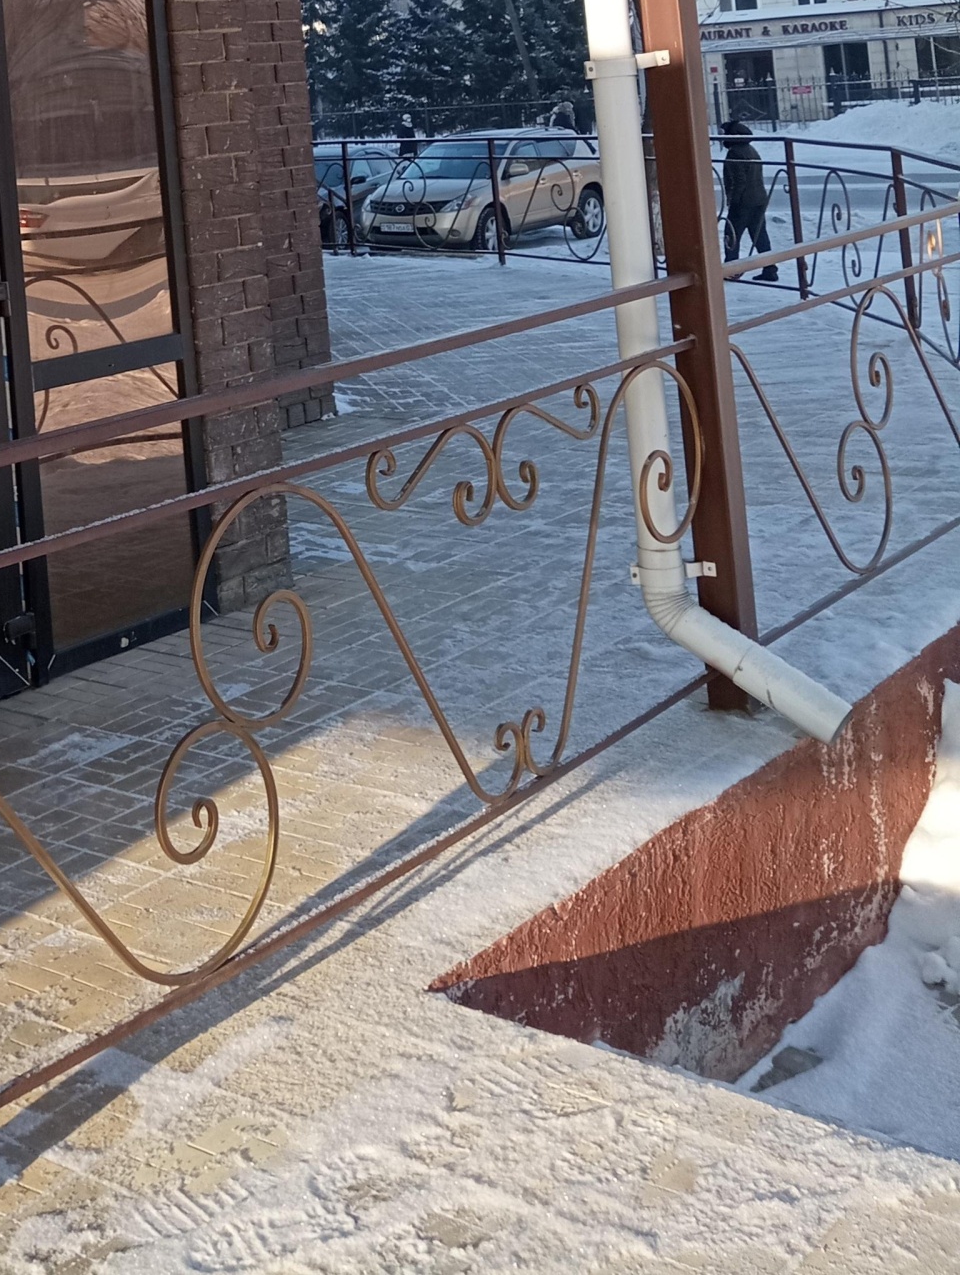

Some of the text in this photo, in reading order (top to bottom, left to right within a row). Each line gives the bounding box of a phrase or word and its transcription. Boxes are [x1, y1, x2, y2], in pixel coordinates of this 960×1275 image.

[896, 12, 936, 27] KIDS
[700, 26, 752, 41] AURANT
[781, 20, 849, 36] KARAOKE
